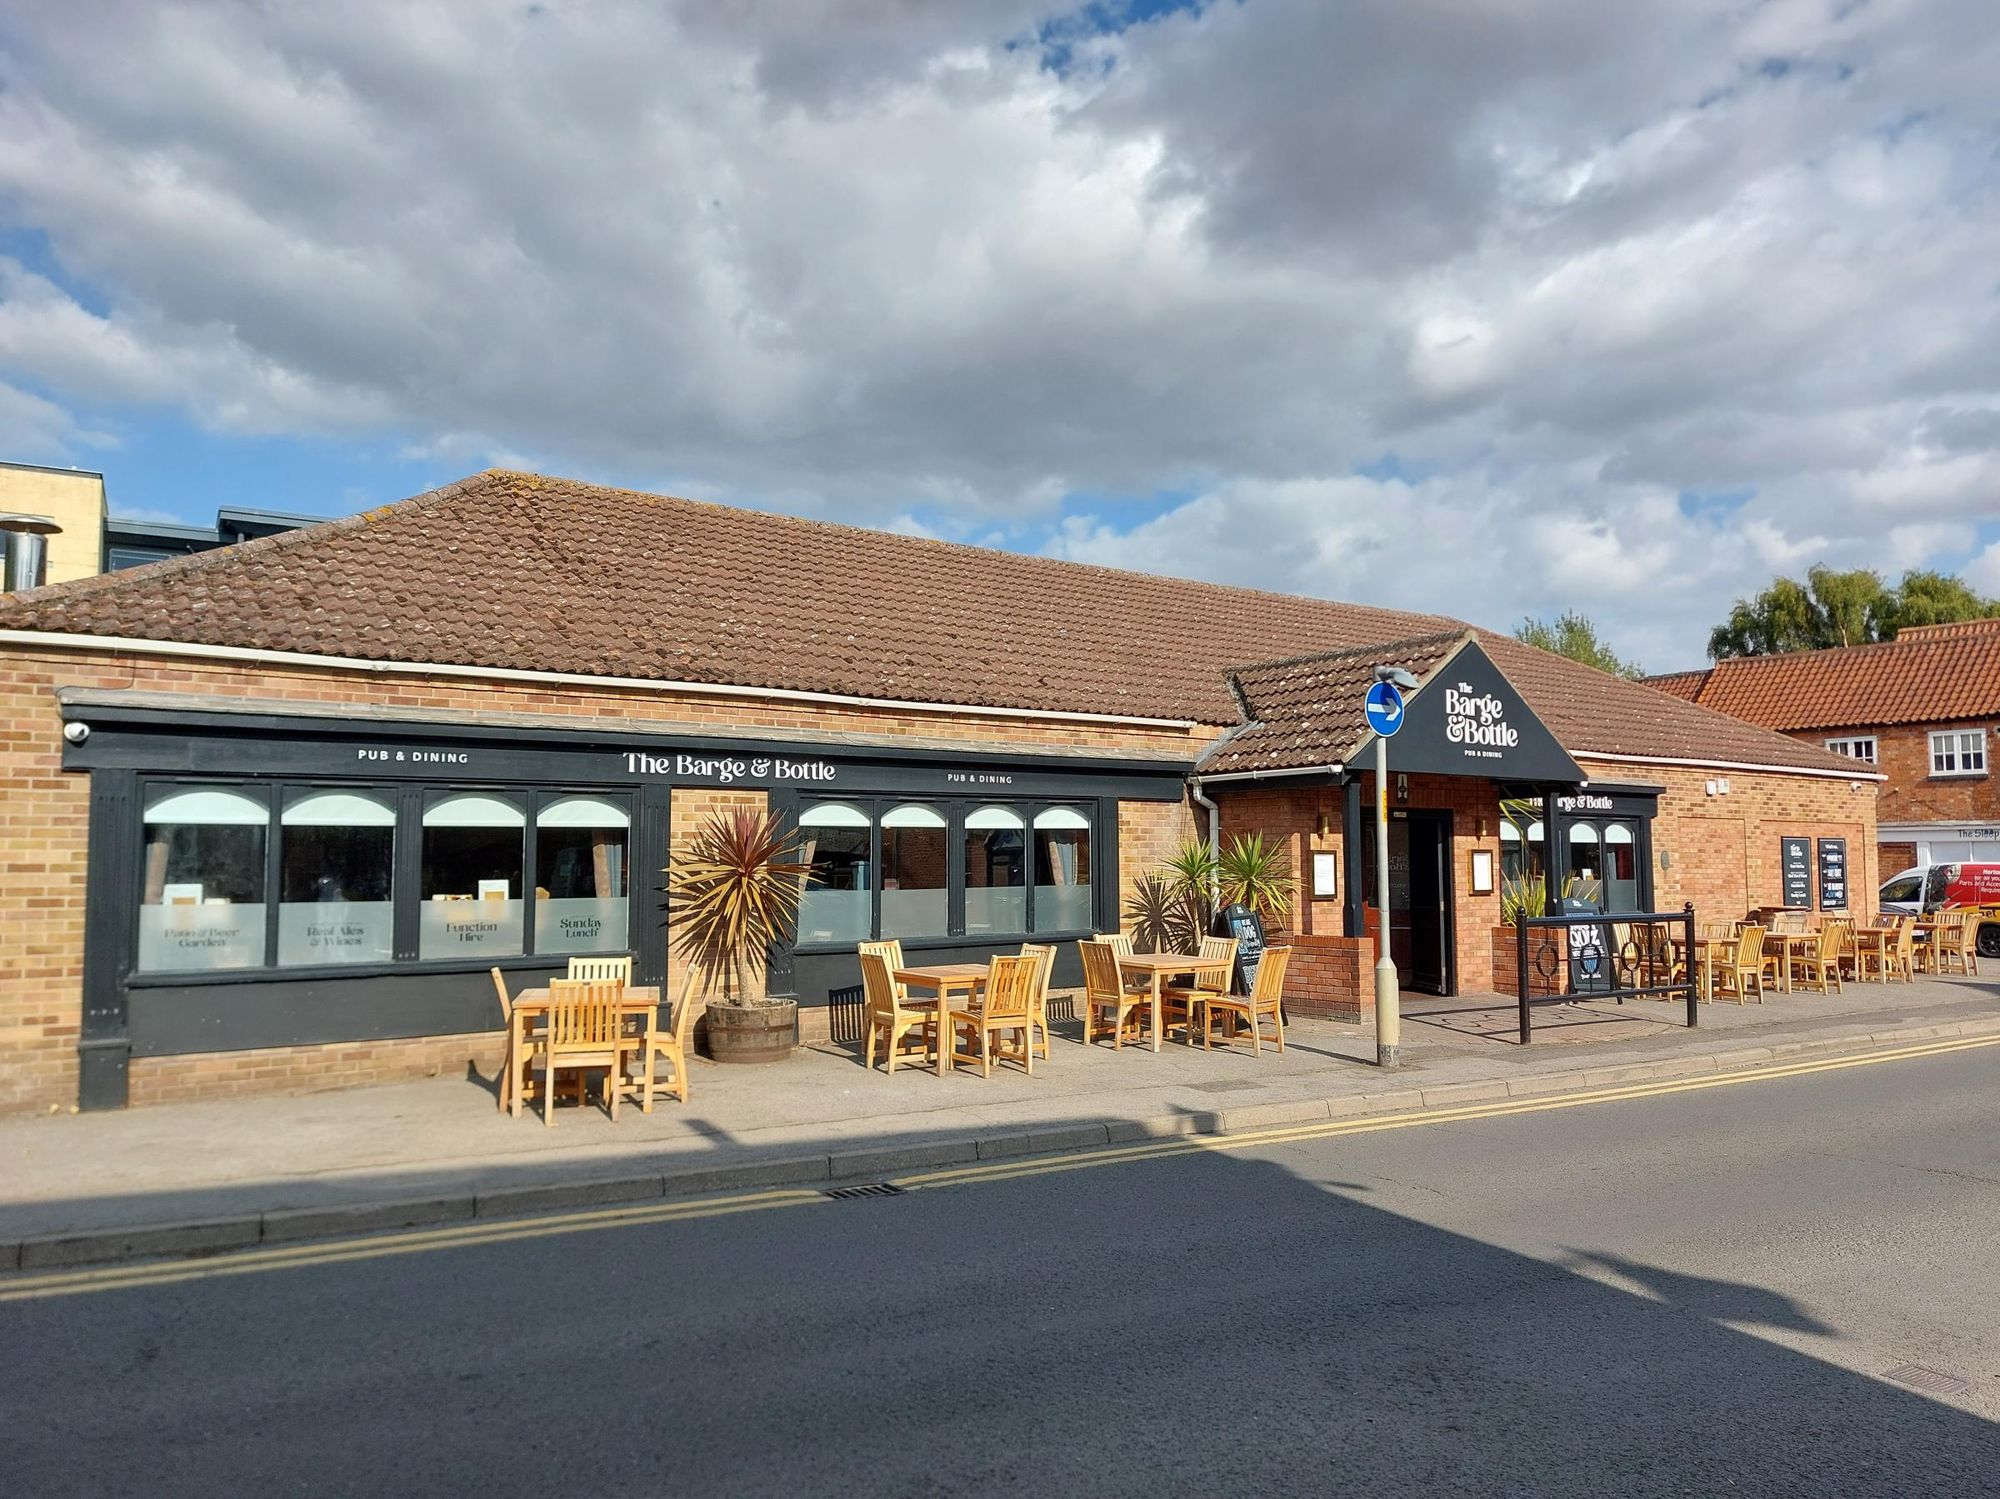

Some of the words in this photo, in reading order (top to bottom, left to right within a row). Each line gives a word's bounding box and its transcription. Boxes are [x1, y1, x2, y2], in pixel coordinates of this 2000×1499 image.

[1458, 682, 1473, 693] The
[1445, 689, 1503, 726] Barge
[358, 749, 389, 761] PUB
[395, 751, 405, 761] &
[412, 751, 468, 763] DINING
[623, 752, 670, 774] The
[676, 754, 746, 783] Barge
[750, 757, 771, 778] &
[774, 759, 836, 780] Bottle
[947, 773, 966, 782] PUB
[969, 774, 976, 783] &
[979, 775, 1012, 784] DINING
[1586, 796, 1613, 809] Bottle
[1958, 829, 1973, 838] The
[446, 922, 497, 933] Function
[560, 917, 601, 930] Sunday
[459, 932, 484, 942] Hire
[566, 929, 598, 938] Lunch
[1570, 928, 1601, 947] QUIZ
